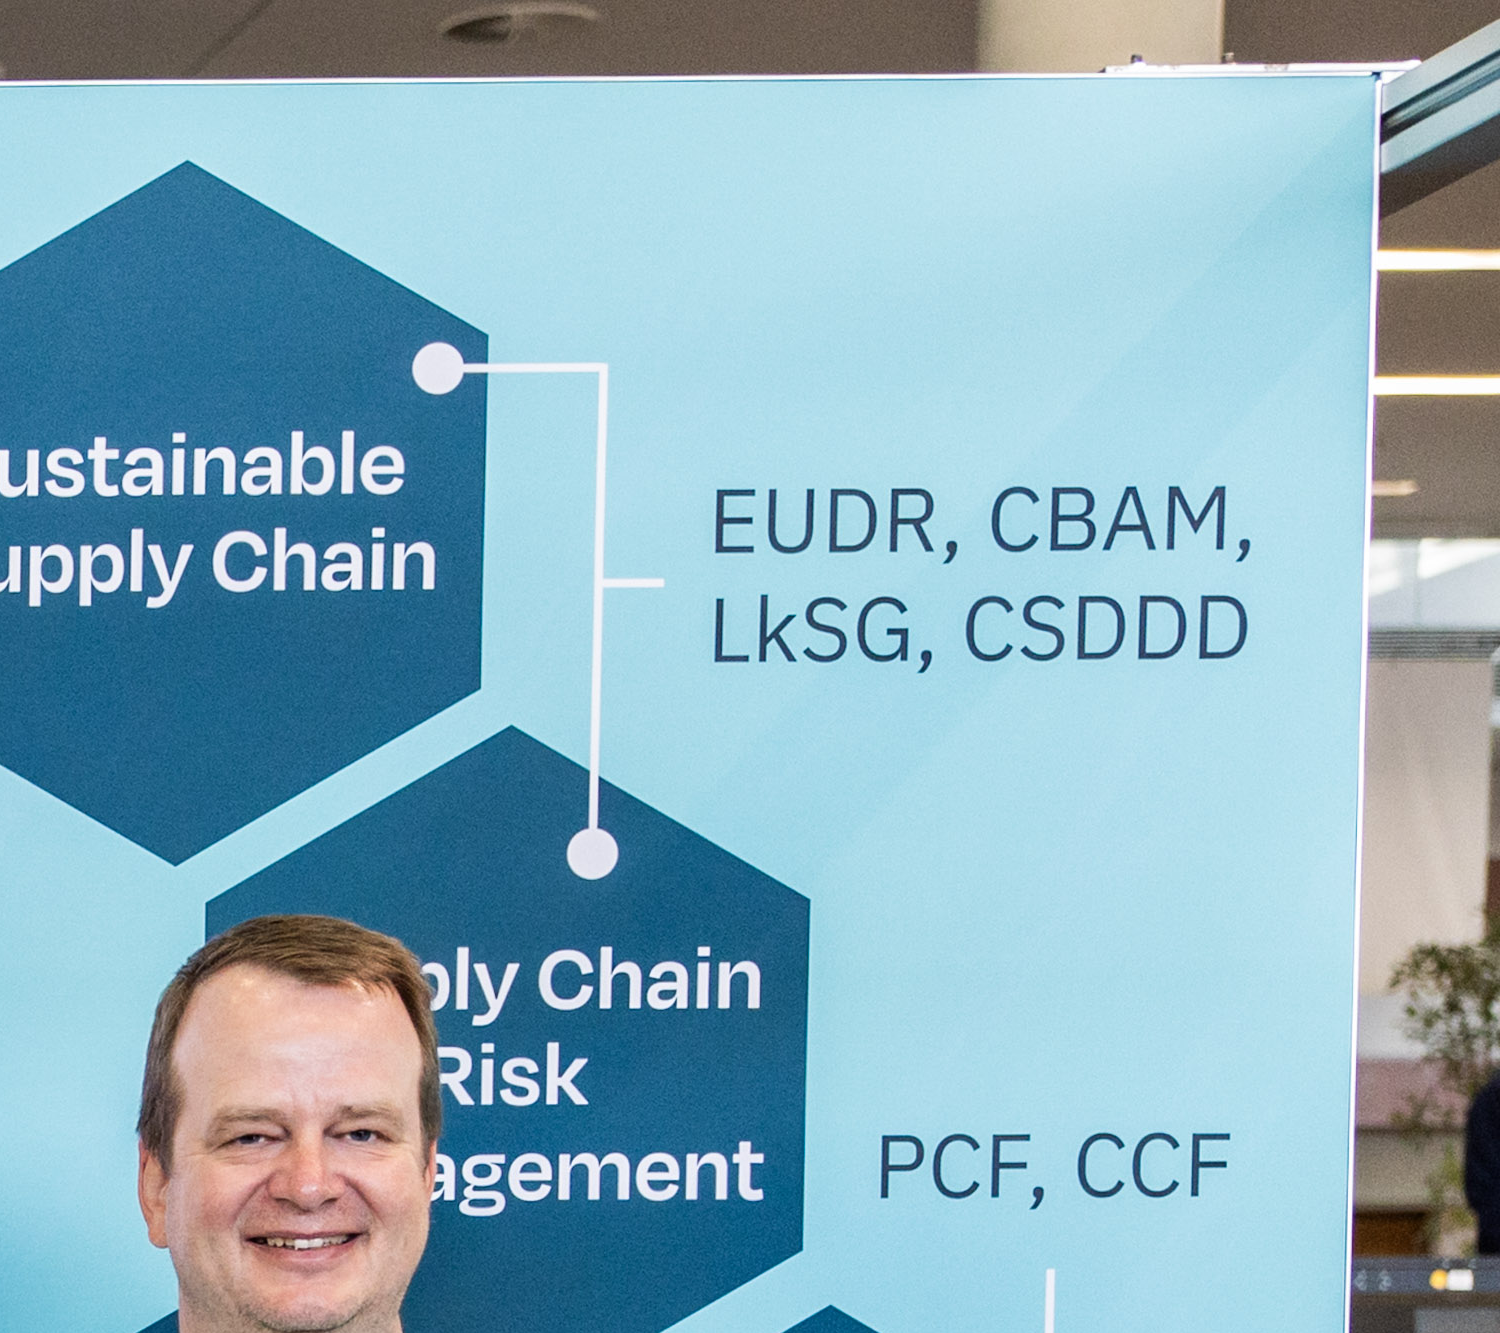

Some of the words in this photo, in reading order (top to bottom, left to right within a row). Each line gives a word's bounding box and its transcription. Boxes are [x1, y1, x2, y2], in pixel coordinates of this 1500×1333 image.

[213, 528, 435, 592] Chain
[715, 488, 957, 564] EUDR,
[992, 486, 1250, 562] CBAM,
[715, 595, 932, 673] LkSG,
[966, 595, 1247, 661] CSDDD
[539, 946, 760, 1010] Chain
[437, 1042, 589, 1106] Risk
[430, 1141, 764, 1216] agement
[881, 1134, 1044, 1209] PCF,
[1078, 1133, 1230, 1198] CCF
